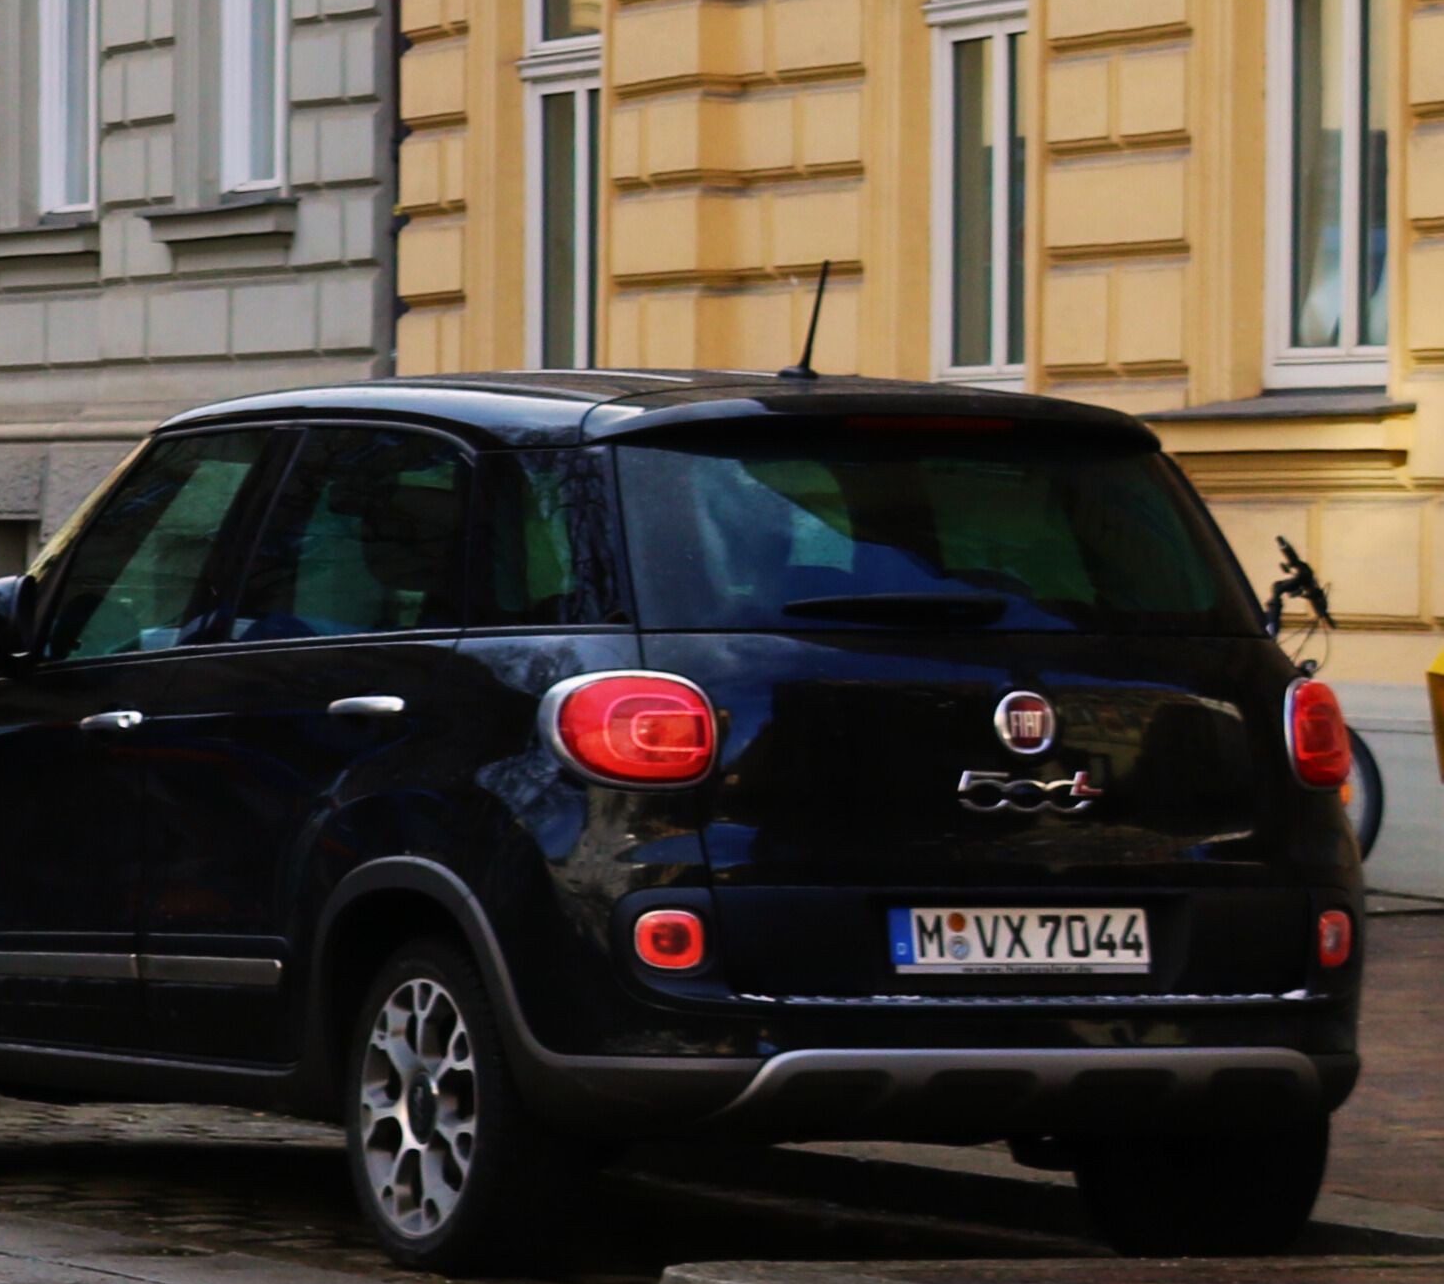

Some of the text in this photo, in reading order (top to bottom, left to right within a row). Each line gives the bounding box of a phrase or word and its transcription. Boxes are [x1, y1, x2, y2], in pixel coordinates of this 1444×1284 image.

[1009, 710, 1044, 738] FIAT
[916, 914, 945, 958] M
[973, 914, 1032, 958] VX
[1036, 914, 1144, 958] 7044
